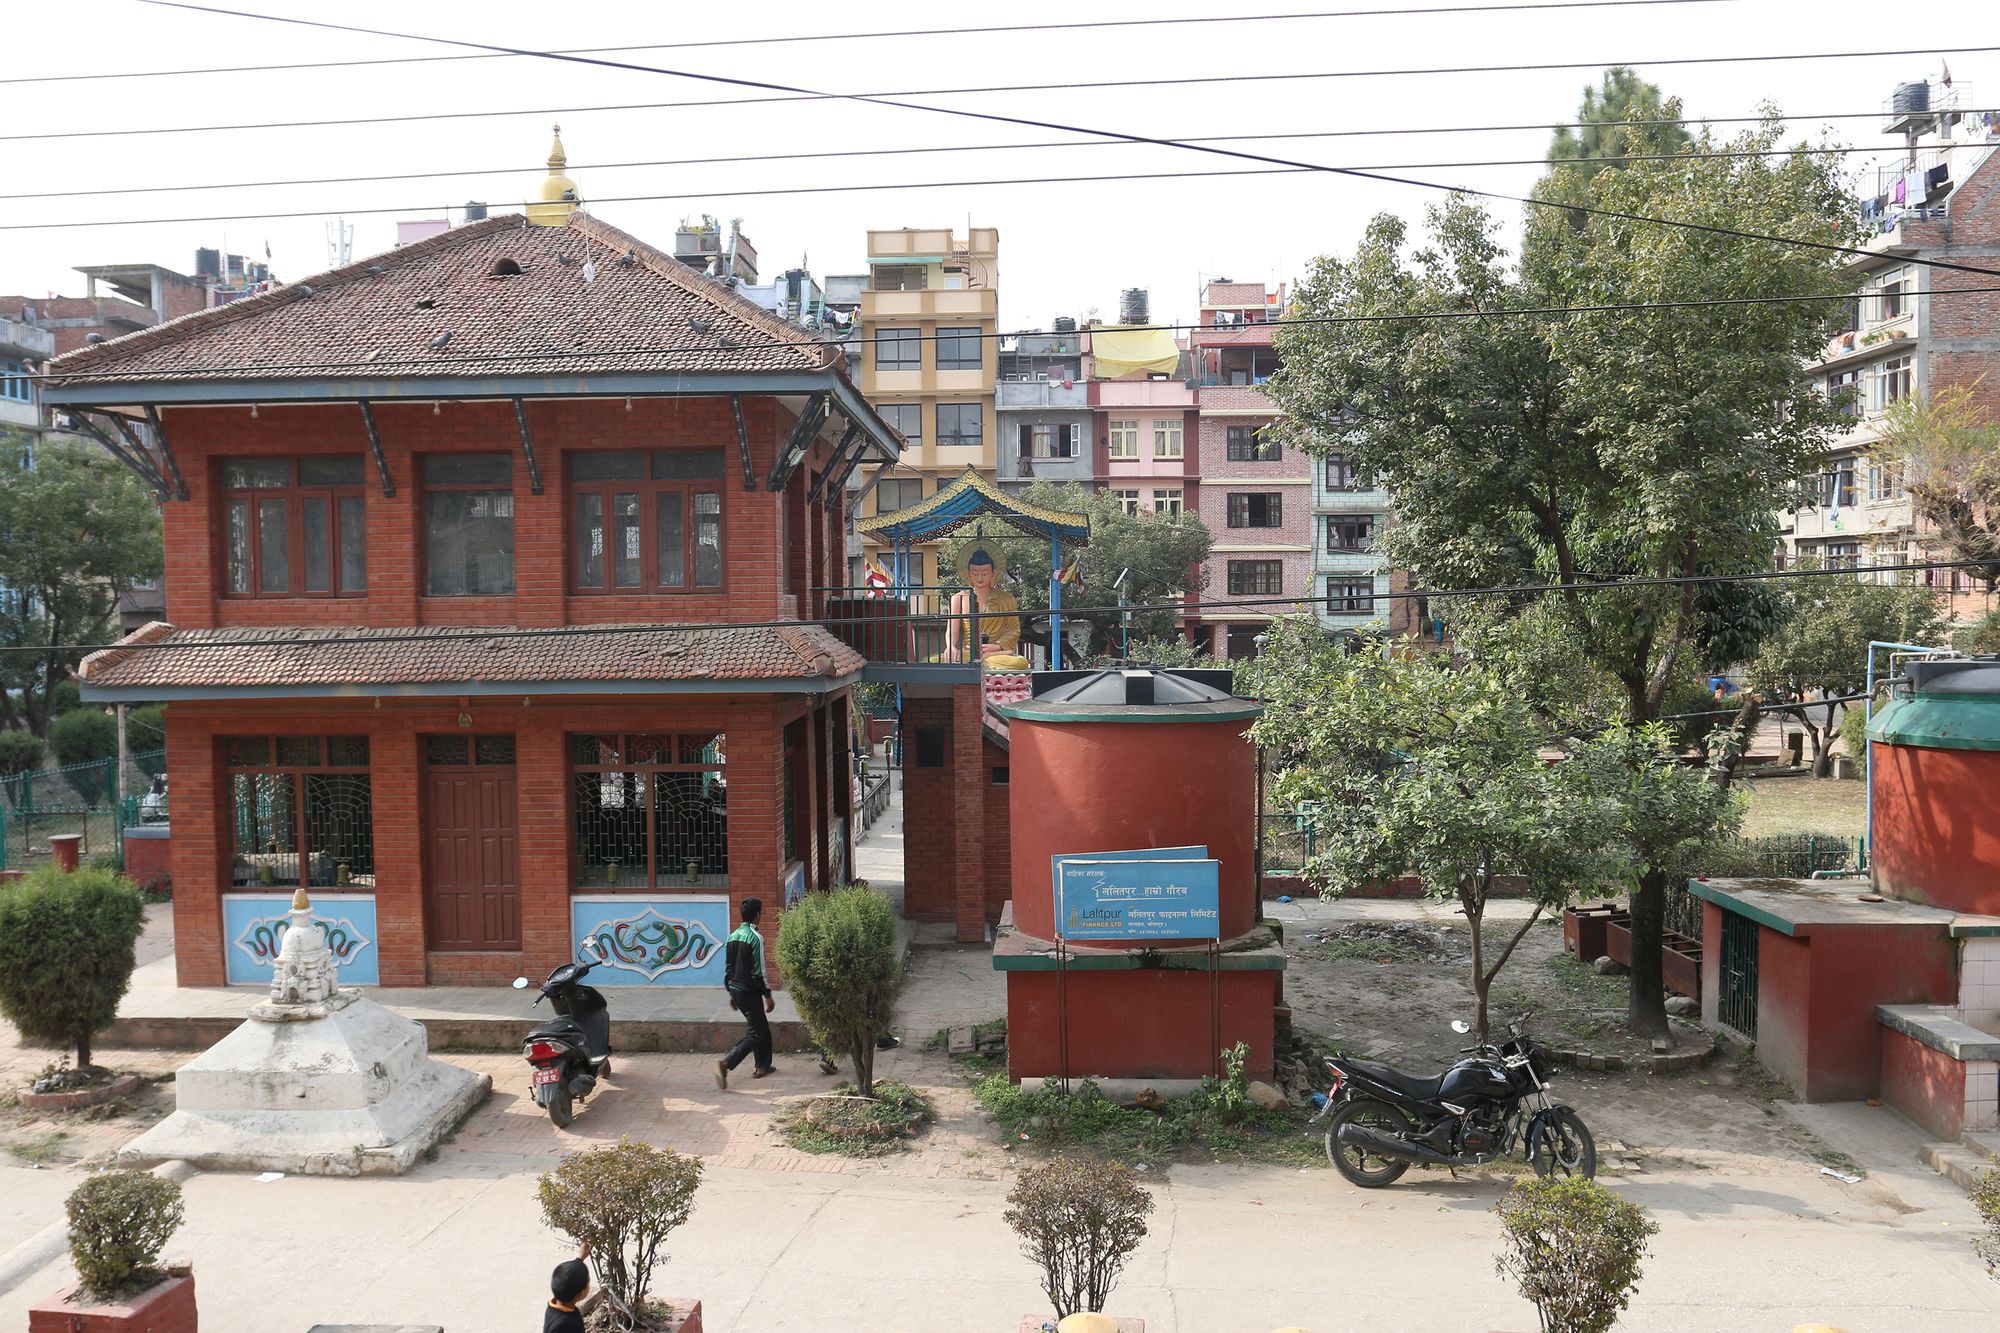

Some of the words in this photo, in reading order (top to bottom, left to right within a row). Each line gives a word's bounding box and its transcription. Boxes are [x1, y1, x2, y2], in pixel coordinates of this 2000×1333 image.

[1166, 884, 1188, 896] गौरव
[1082, 908, 1122, 920] Lalitpur
[1128, 909, 1156, 921] ललितपुर
[1190, 909, 1217, 919] लिमिटेड
